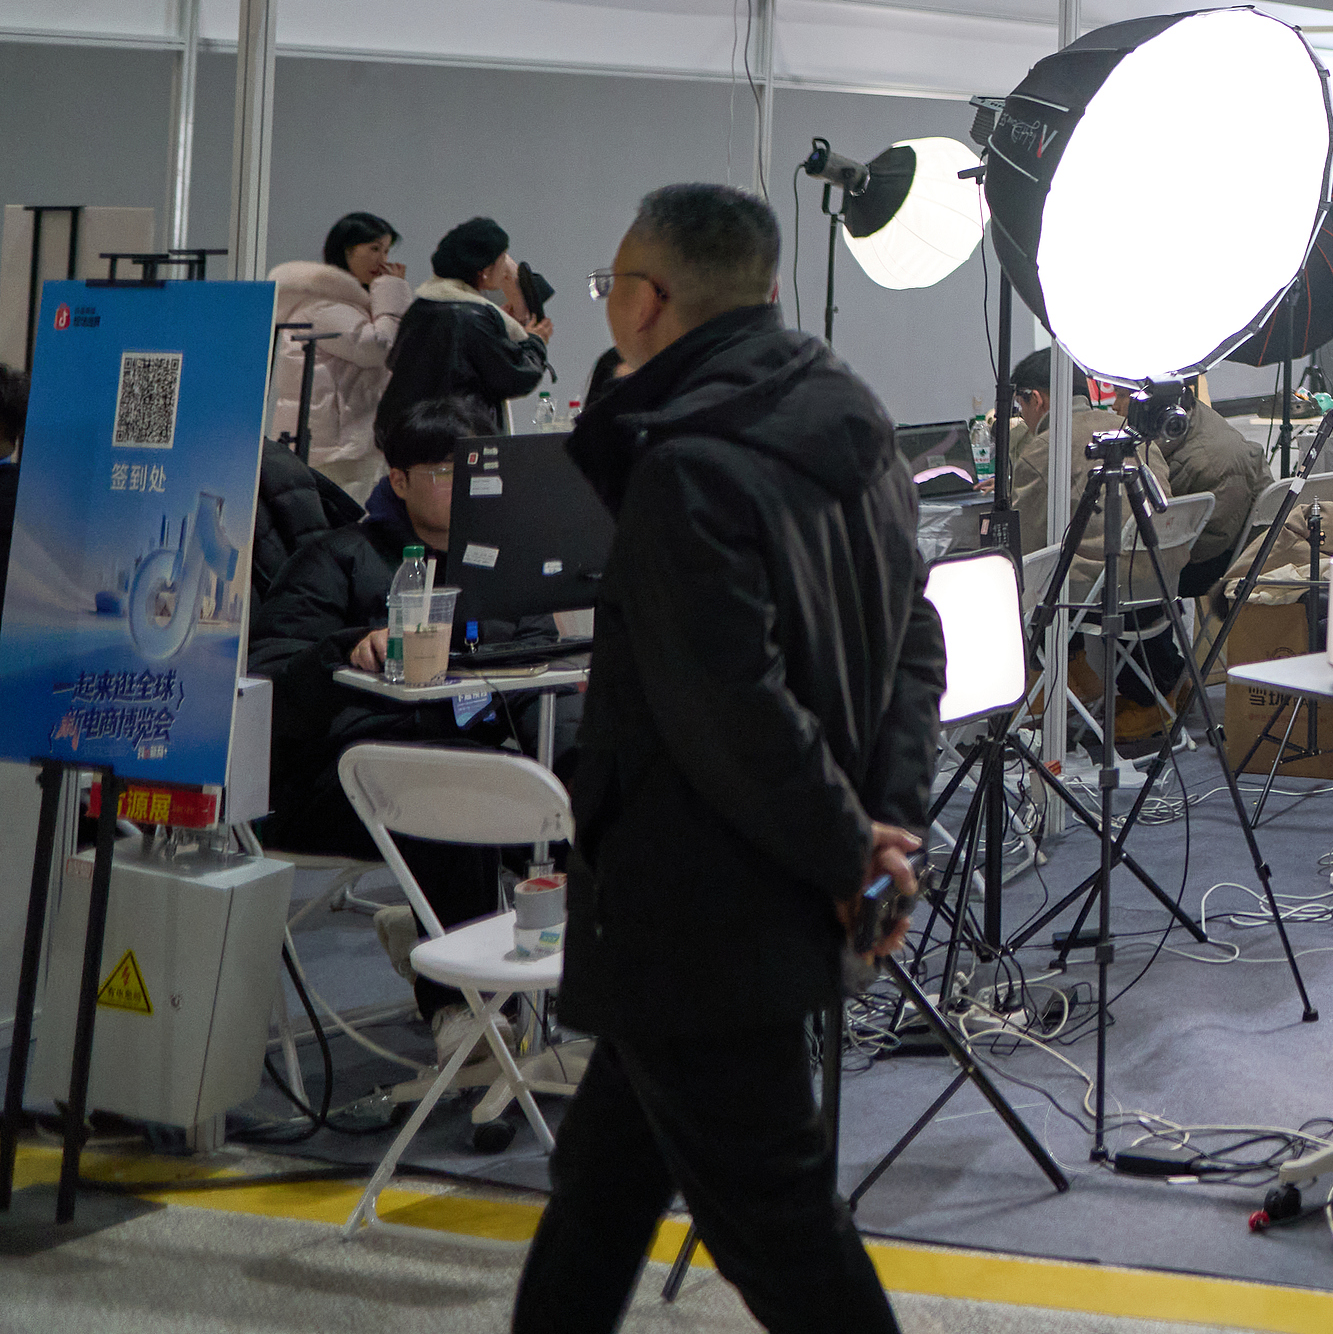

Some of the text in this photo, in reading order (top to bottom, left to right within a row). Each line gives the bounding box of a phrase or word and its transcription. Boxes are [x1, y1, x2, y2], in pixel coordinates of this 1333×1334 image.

[110, 463, 167, 493] 签到处
[52, 669, 177, 704] 一起来逛全球
[55, 705, 176, 752] 新电商博览会
